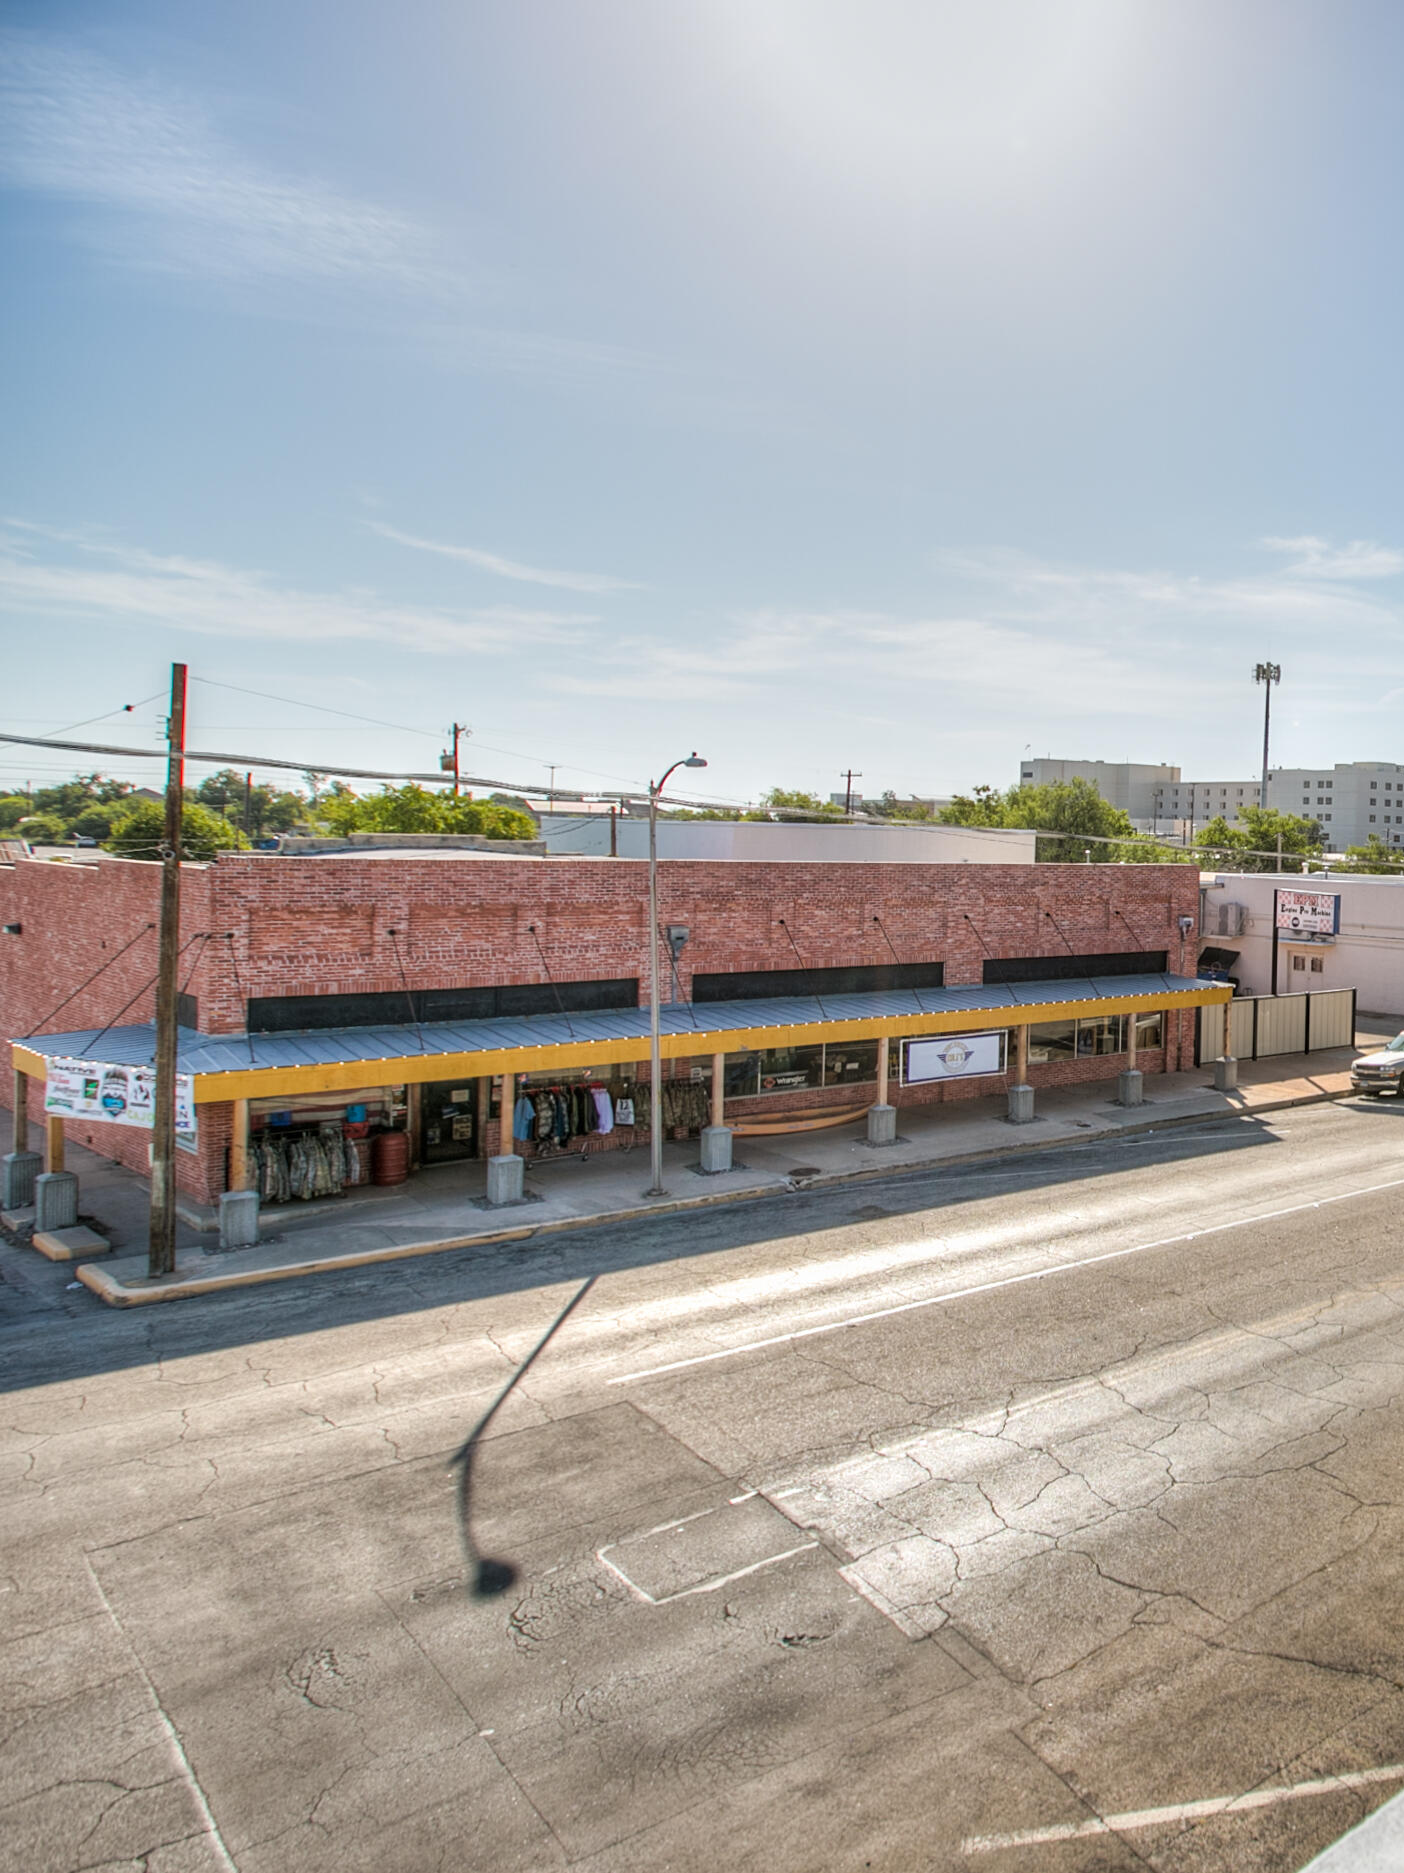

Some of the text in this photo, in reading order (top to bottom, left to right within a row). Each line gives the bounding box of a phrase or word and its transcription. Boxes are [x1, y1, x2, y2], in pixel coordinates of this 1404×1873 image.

[1293, 893, 1319, 906] EPM
[1280, 903, 1331, 917] Engine Pro Machine
[54, 1064, 97, 1075] NATIVE
[776, 1075, 806, 1086] Wrangler
